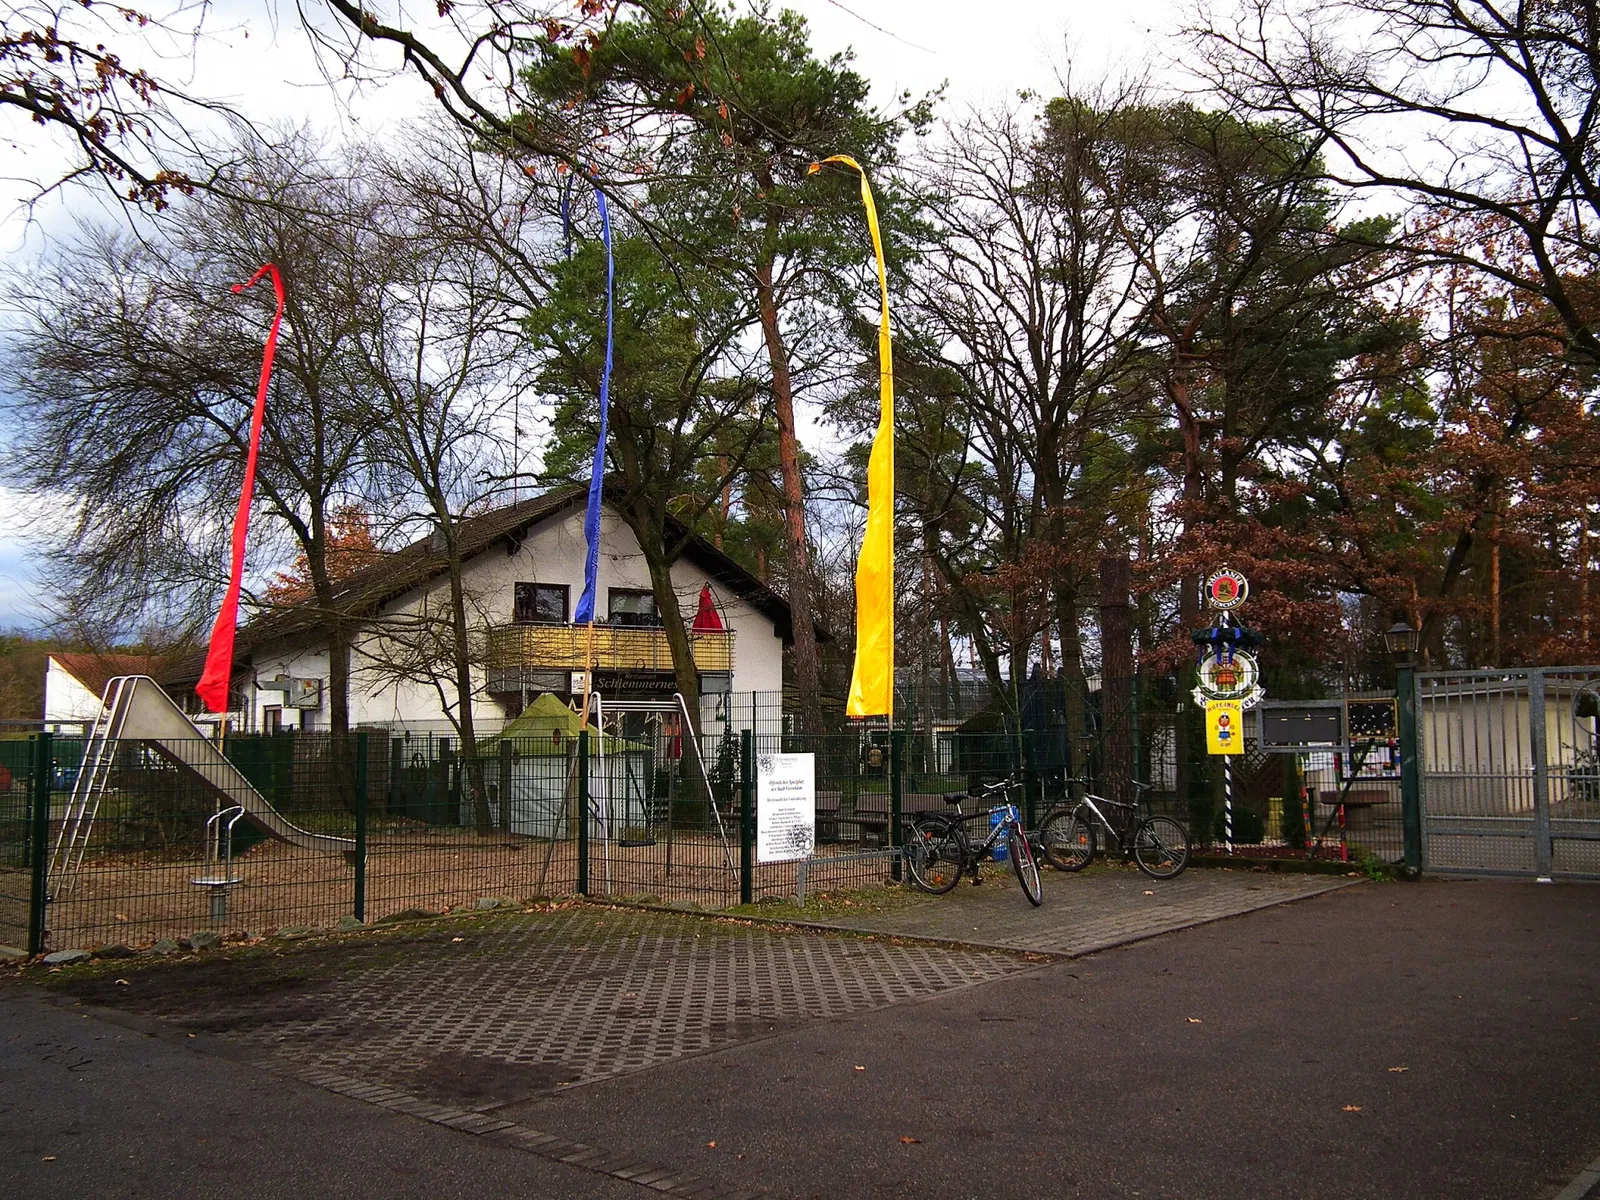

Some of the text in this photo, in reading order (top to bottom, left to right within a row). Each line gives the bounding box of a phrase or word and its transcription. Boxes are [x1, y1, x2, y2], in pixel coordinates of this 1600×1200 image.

[1207, 570, 1244, 587] PAULANER
[625, 672, 657, 680] Restaurant
[597, 677, 679, 690] Schlemmernes
